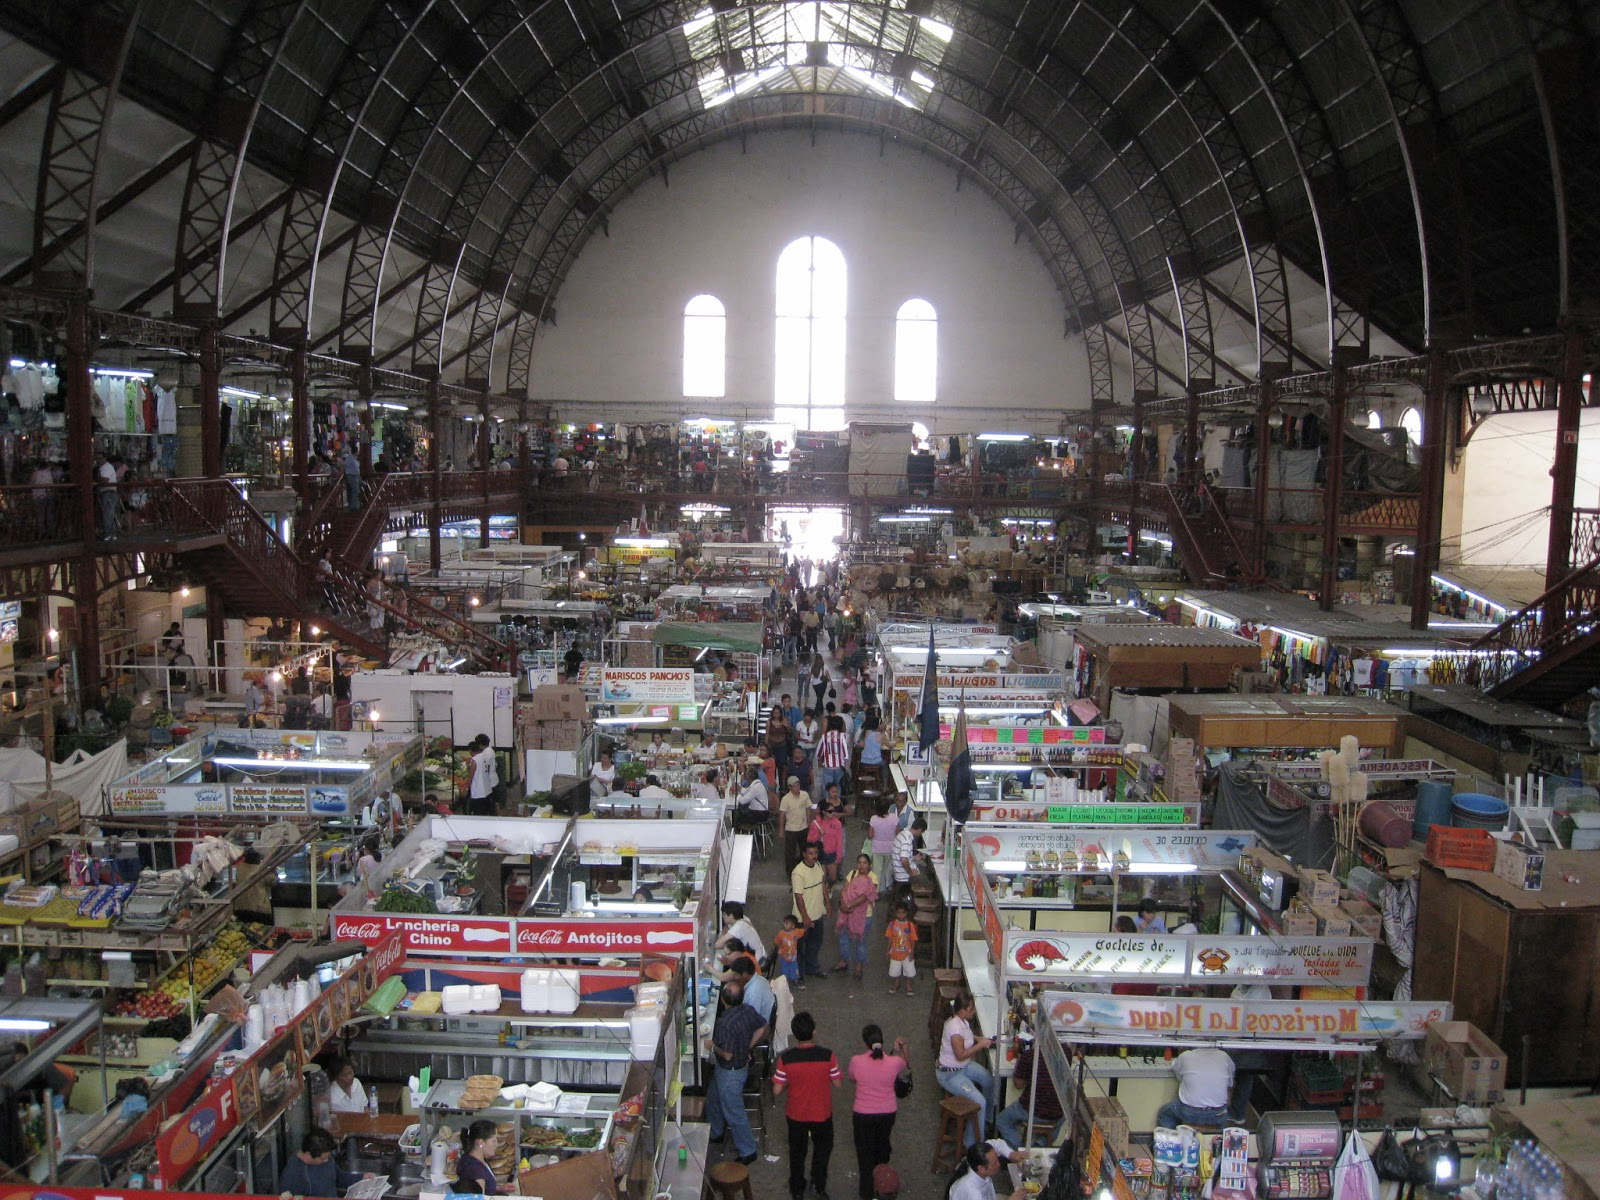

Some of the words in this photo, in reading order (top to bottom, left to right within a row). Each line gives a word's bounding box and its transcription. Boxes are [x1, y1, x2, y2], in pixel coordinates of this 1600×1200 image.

[605, 672, 647, 681] MARISCOS
[649, 672, 690, 681] PANCHO'S
[954, 676, 997, 687] JUGOS
[336, 922, 382, 939] Coca-Cola
[517, 929, 564, 945] Coca-Cola
[409, 933, 452, 945] Chino
[567, 931, 643, 947] Antojitos
[1095, 938, 1145, 952] Cocteles
